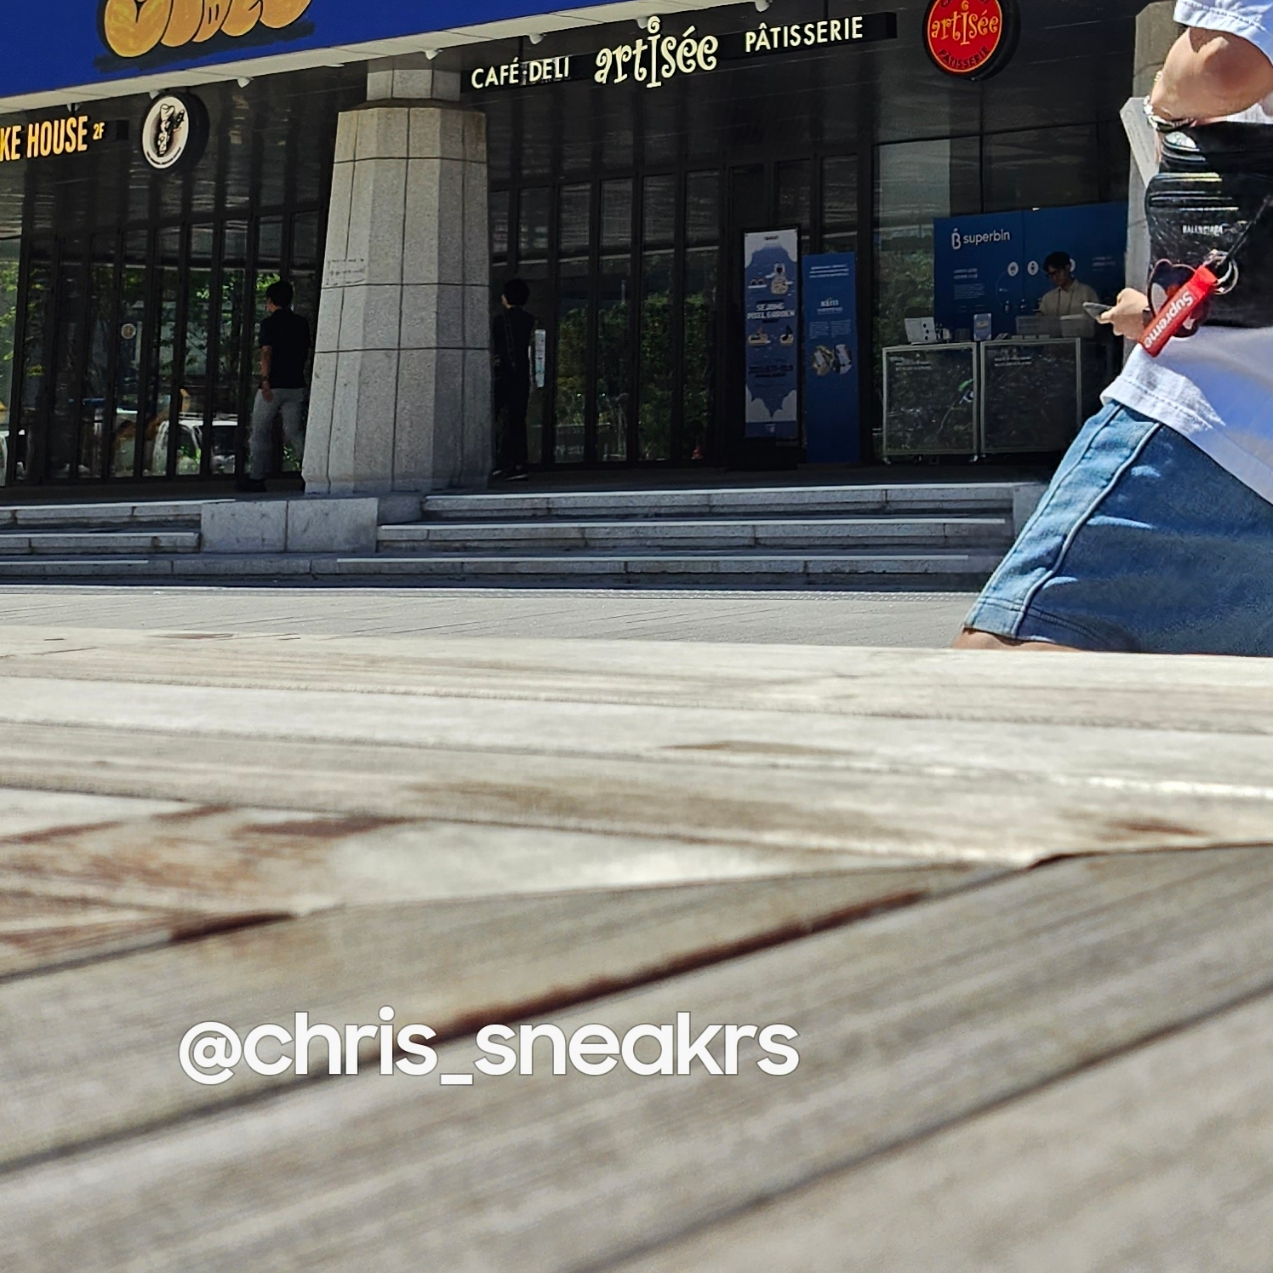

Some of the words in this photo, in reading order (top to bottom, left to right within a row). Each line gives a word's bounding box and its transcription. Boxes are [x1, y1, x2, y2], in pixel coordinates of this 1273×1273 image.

[744, 15, 864, 53] PÂTISSERIE
[26, 115, 88, 159] HOUSE
[92, 122, 106, 141] 2F
[963, 229, 1011, 246] superbin
[1144, 290, 1194, 349] Supreme
